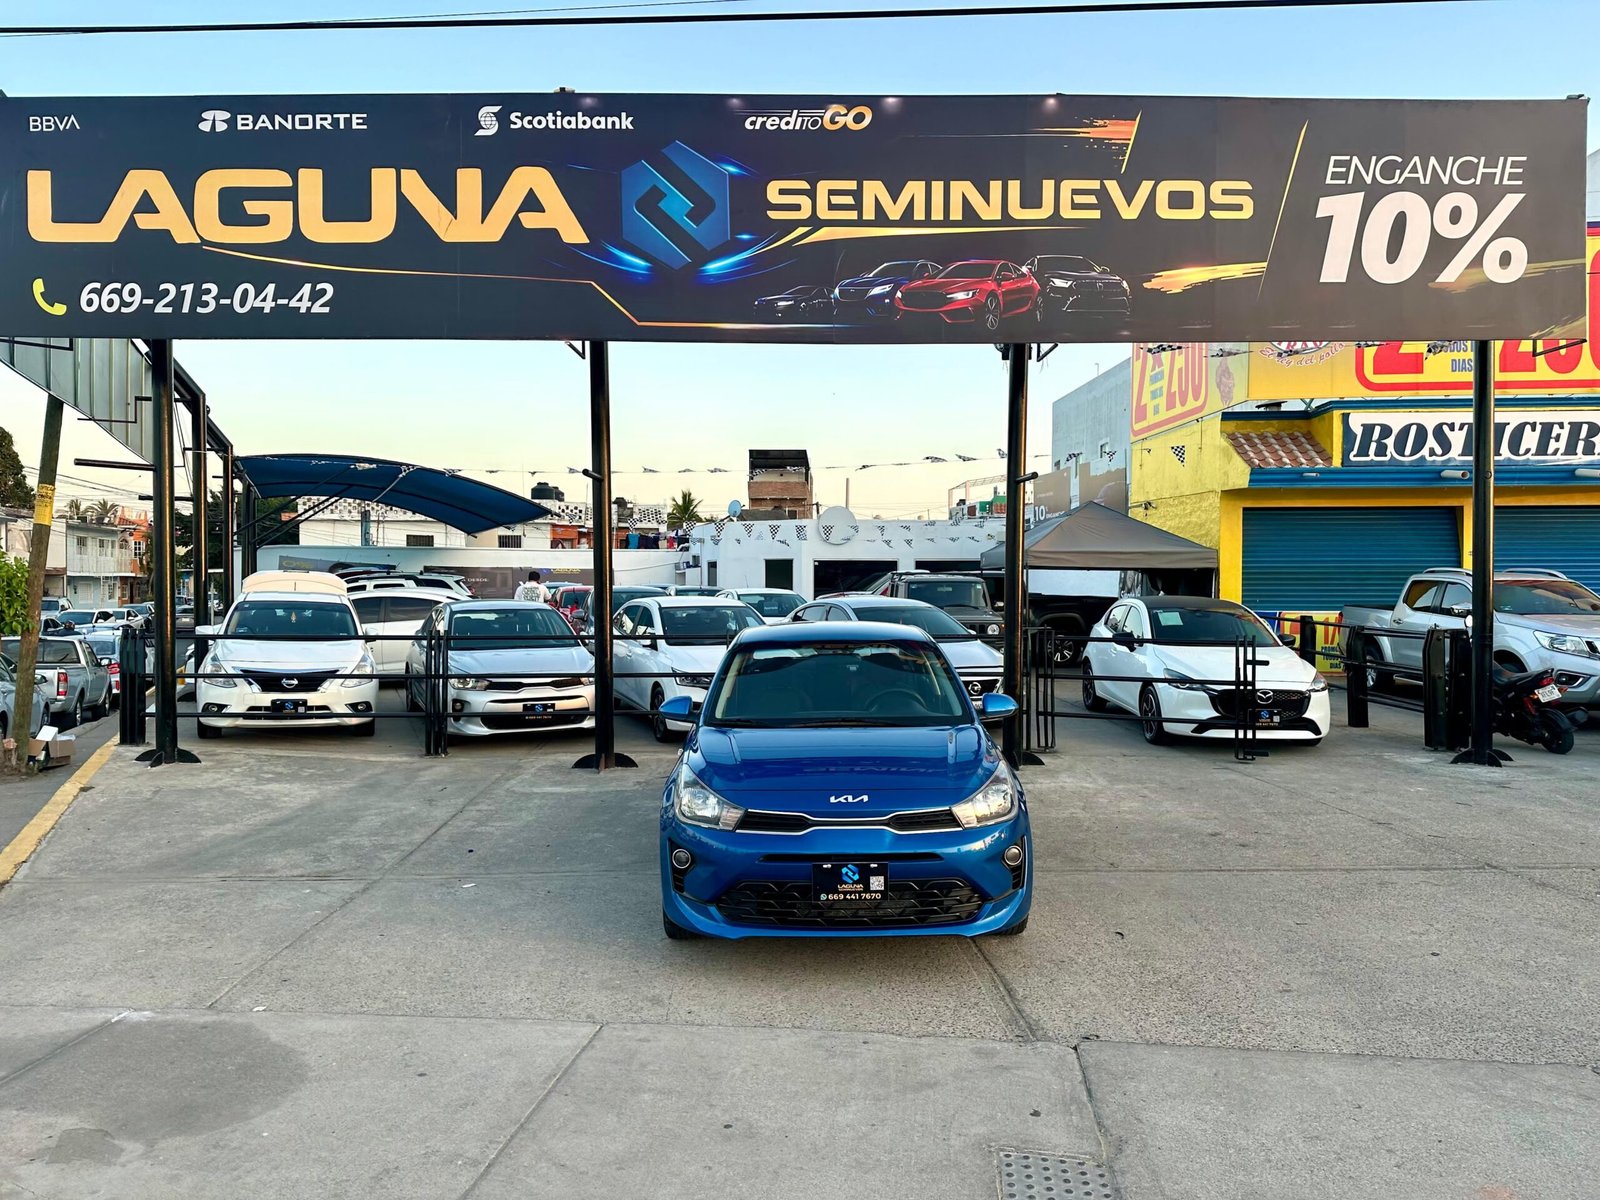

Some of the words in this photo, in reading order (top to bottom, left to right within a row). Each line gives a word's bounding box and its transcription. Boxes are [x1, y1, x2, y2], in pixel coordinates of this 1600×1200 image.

[29, 114, 80, 132] BBVA
[237, 112, 368, 131] BANORTE
[509, 111, 635, 131] Scotiabank
[1325, 155, 1528, 186] ENGANCHE
[27, 166, 590, 245] LAGUNA
[766, 179, 1254, 221] SEMINUEVOS
[1315, 191, 1529, 285] 10%
[80, 282, 335, 315] 669-213-04-42
[1451, 359, 1473, 373] DIAS
